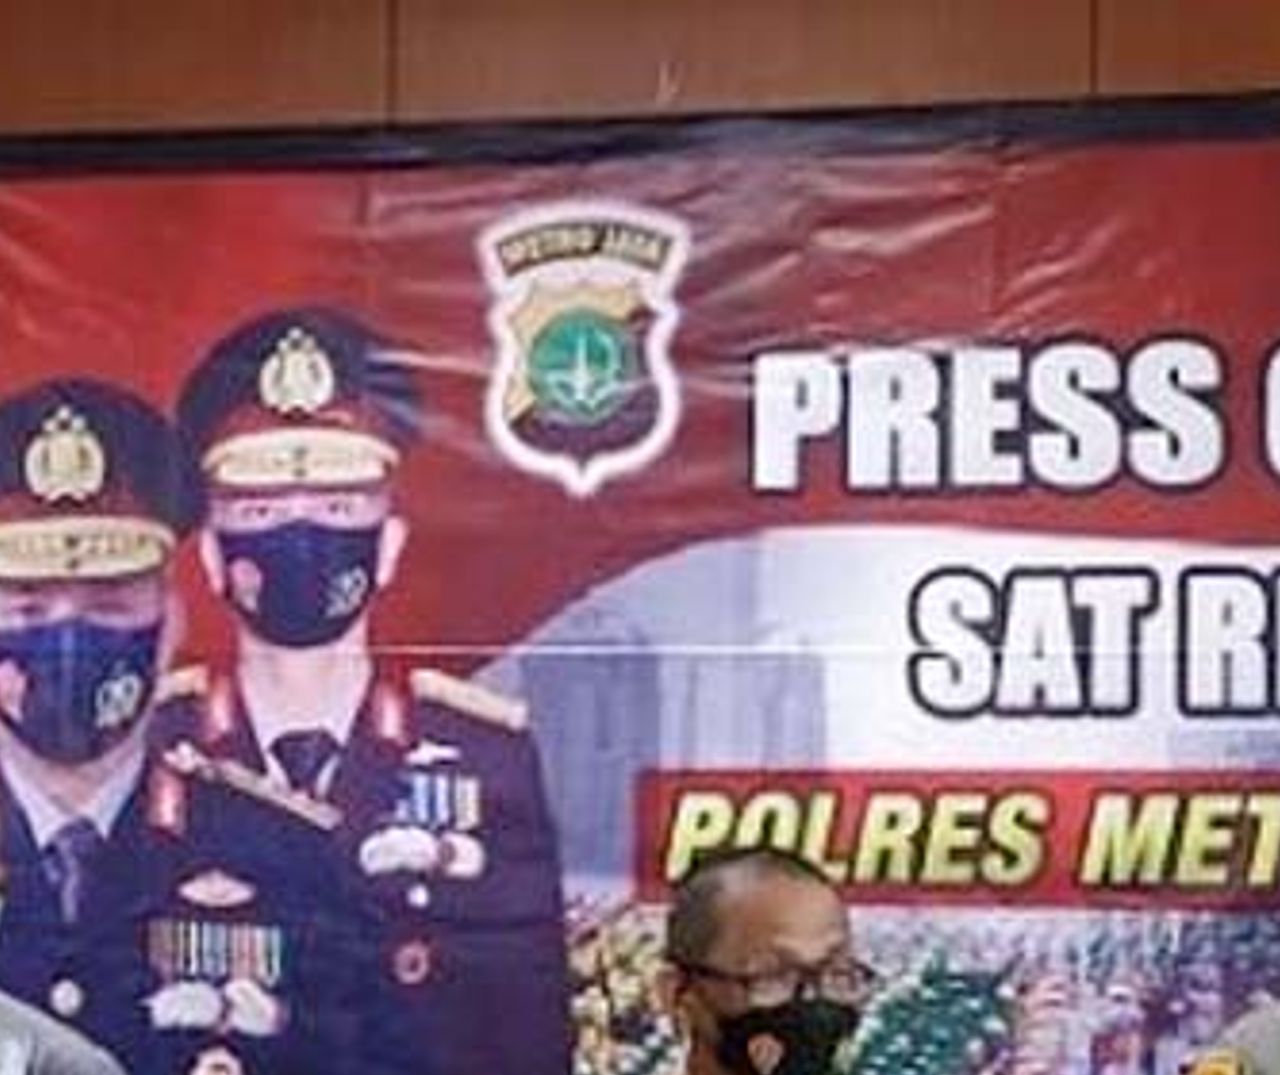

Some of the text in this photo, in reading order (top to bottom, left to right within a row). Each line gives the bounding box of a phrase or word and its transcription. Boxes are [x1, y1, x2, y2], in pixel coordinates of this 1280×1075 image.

[749, 336, 1226, 492] PRESS
[914, 571, 1154, 716] SAT
[664, 791, 1048, 886] POLRES
